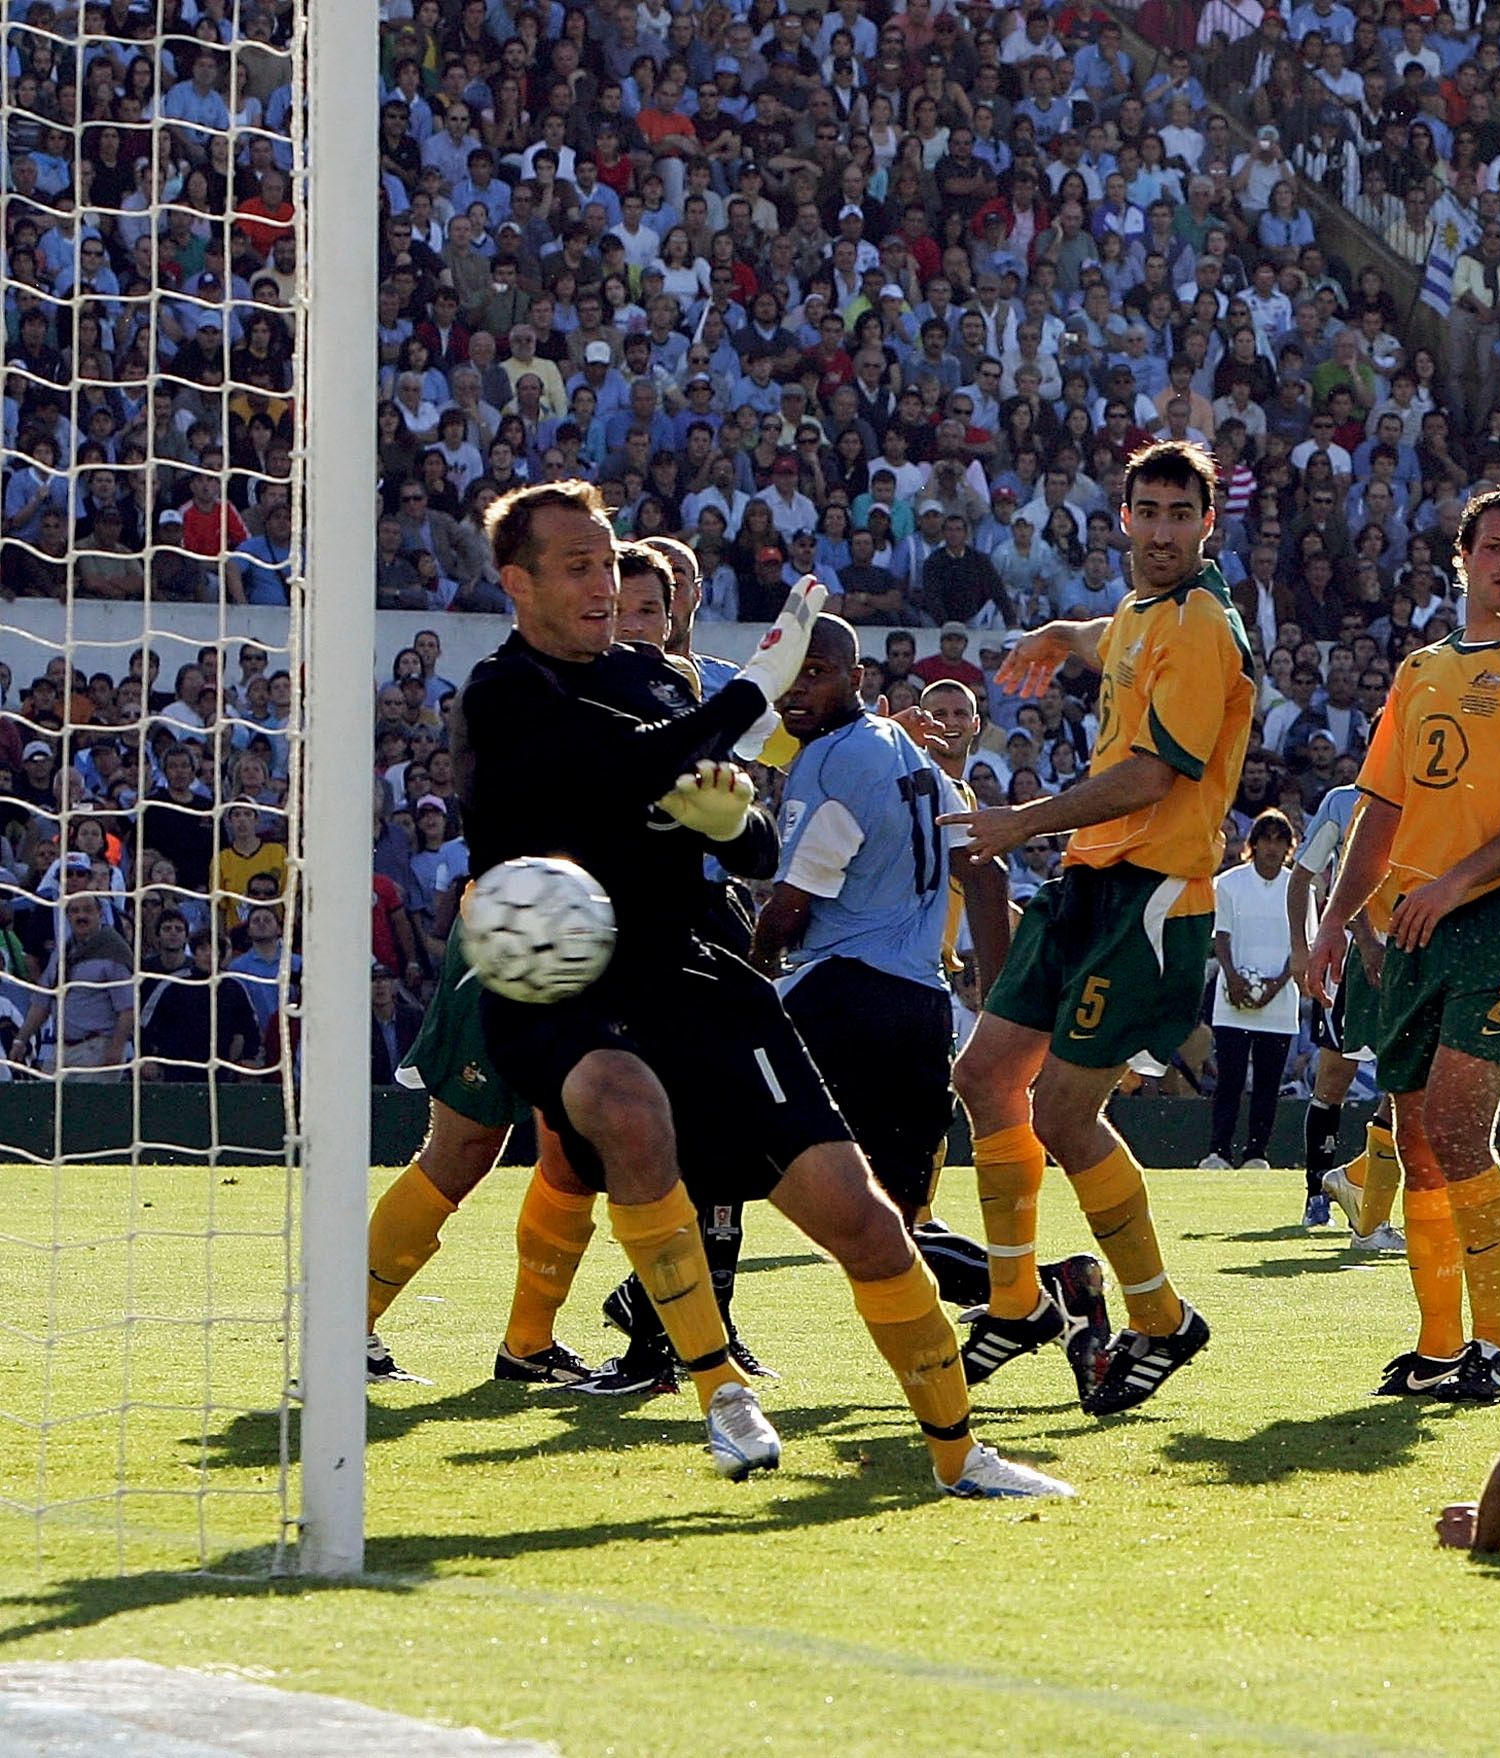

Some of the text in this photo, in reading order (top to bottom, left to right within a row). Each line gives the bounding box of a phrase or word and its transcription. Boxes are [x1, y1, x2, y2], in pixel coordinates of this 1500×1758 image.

[1427, 729, 1449, 777] 2
[1076, 975, 1111, 1028] 5
[753, 1047, 787, 1104] 1
